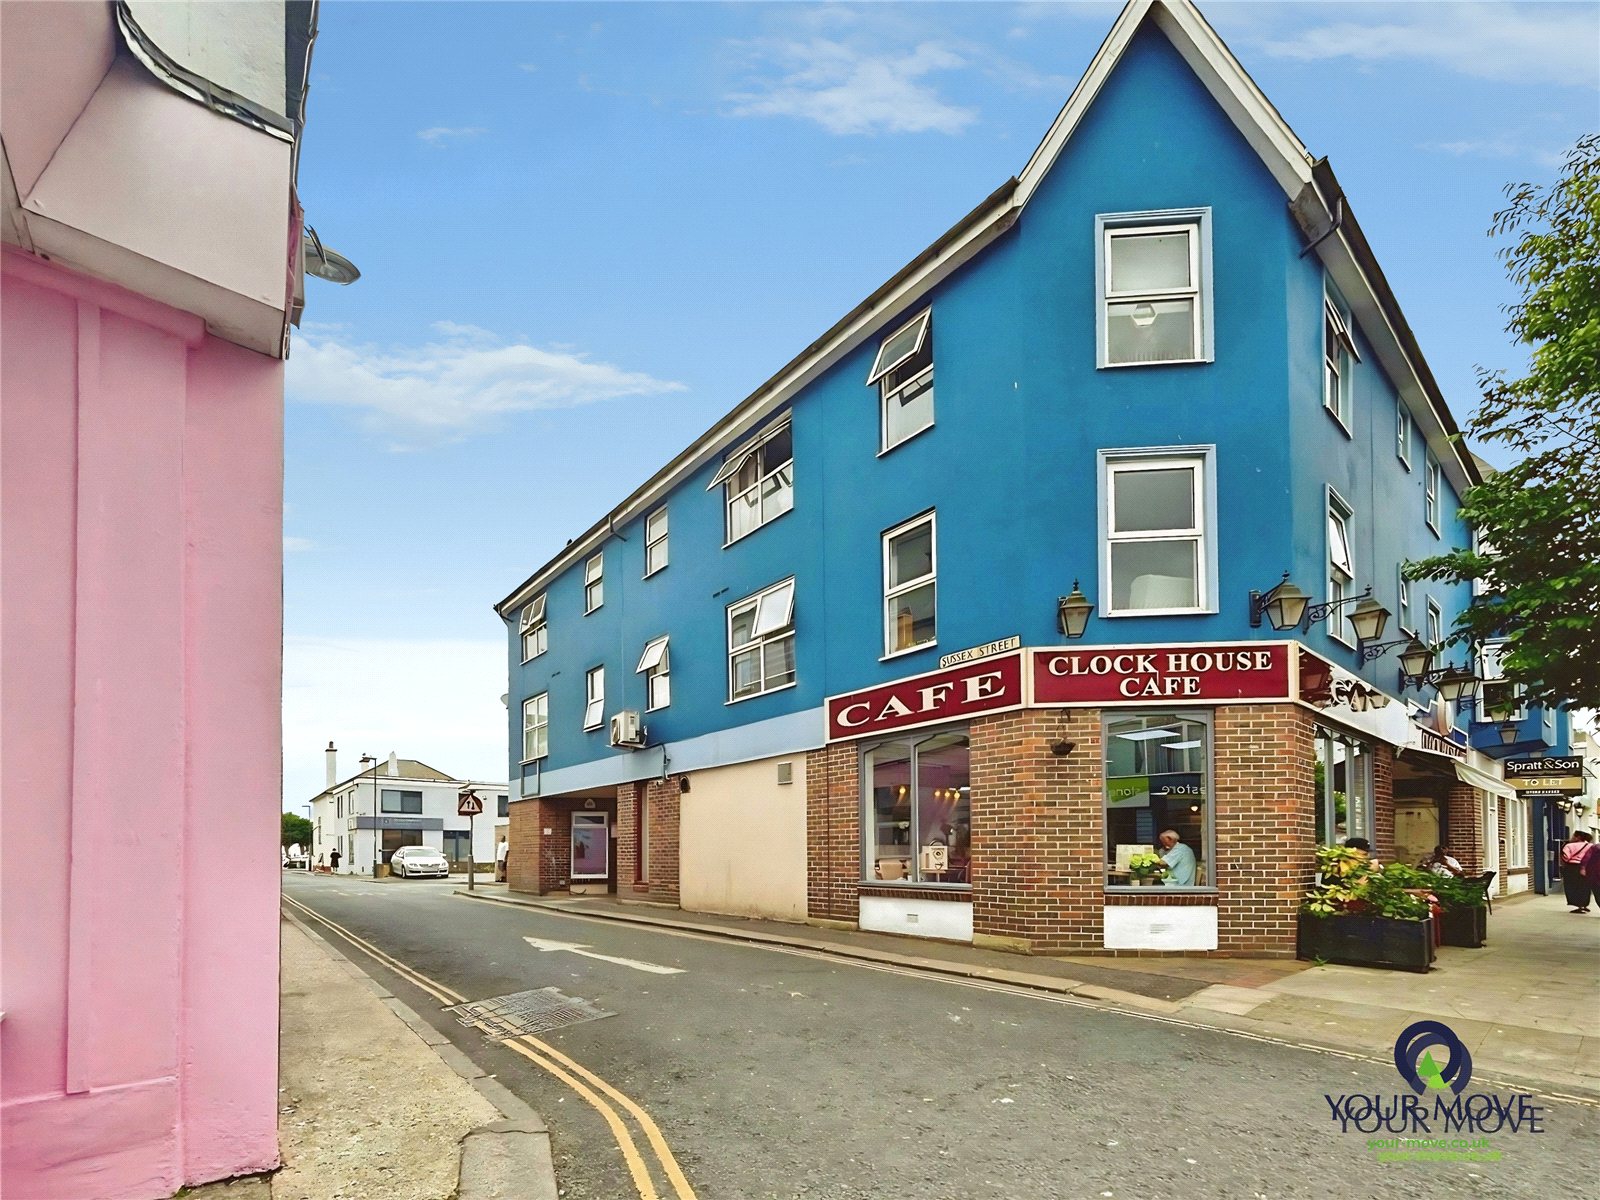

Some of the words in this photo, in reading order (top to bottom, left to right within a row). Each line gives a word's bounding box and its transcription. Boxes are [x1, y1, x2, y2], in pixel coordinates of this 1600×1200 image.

[942, 650, 973, 667] SUSSEX
[979, 638, 1016, 656] STREET
[1048, 654, 1158, 676] CLOCK
[1166, 651, 1273, 672] HOUSE
[836, 670, 1006, 727] CAFE
[1119, 676, 1201, 697] CAFE
[1507, 761, 1542, 772] Spratt
[1555, 759, 1579, 769] Son
